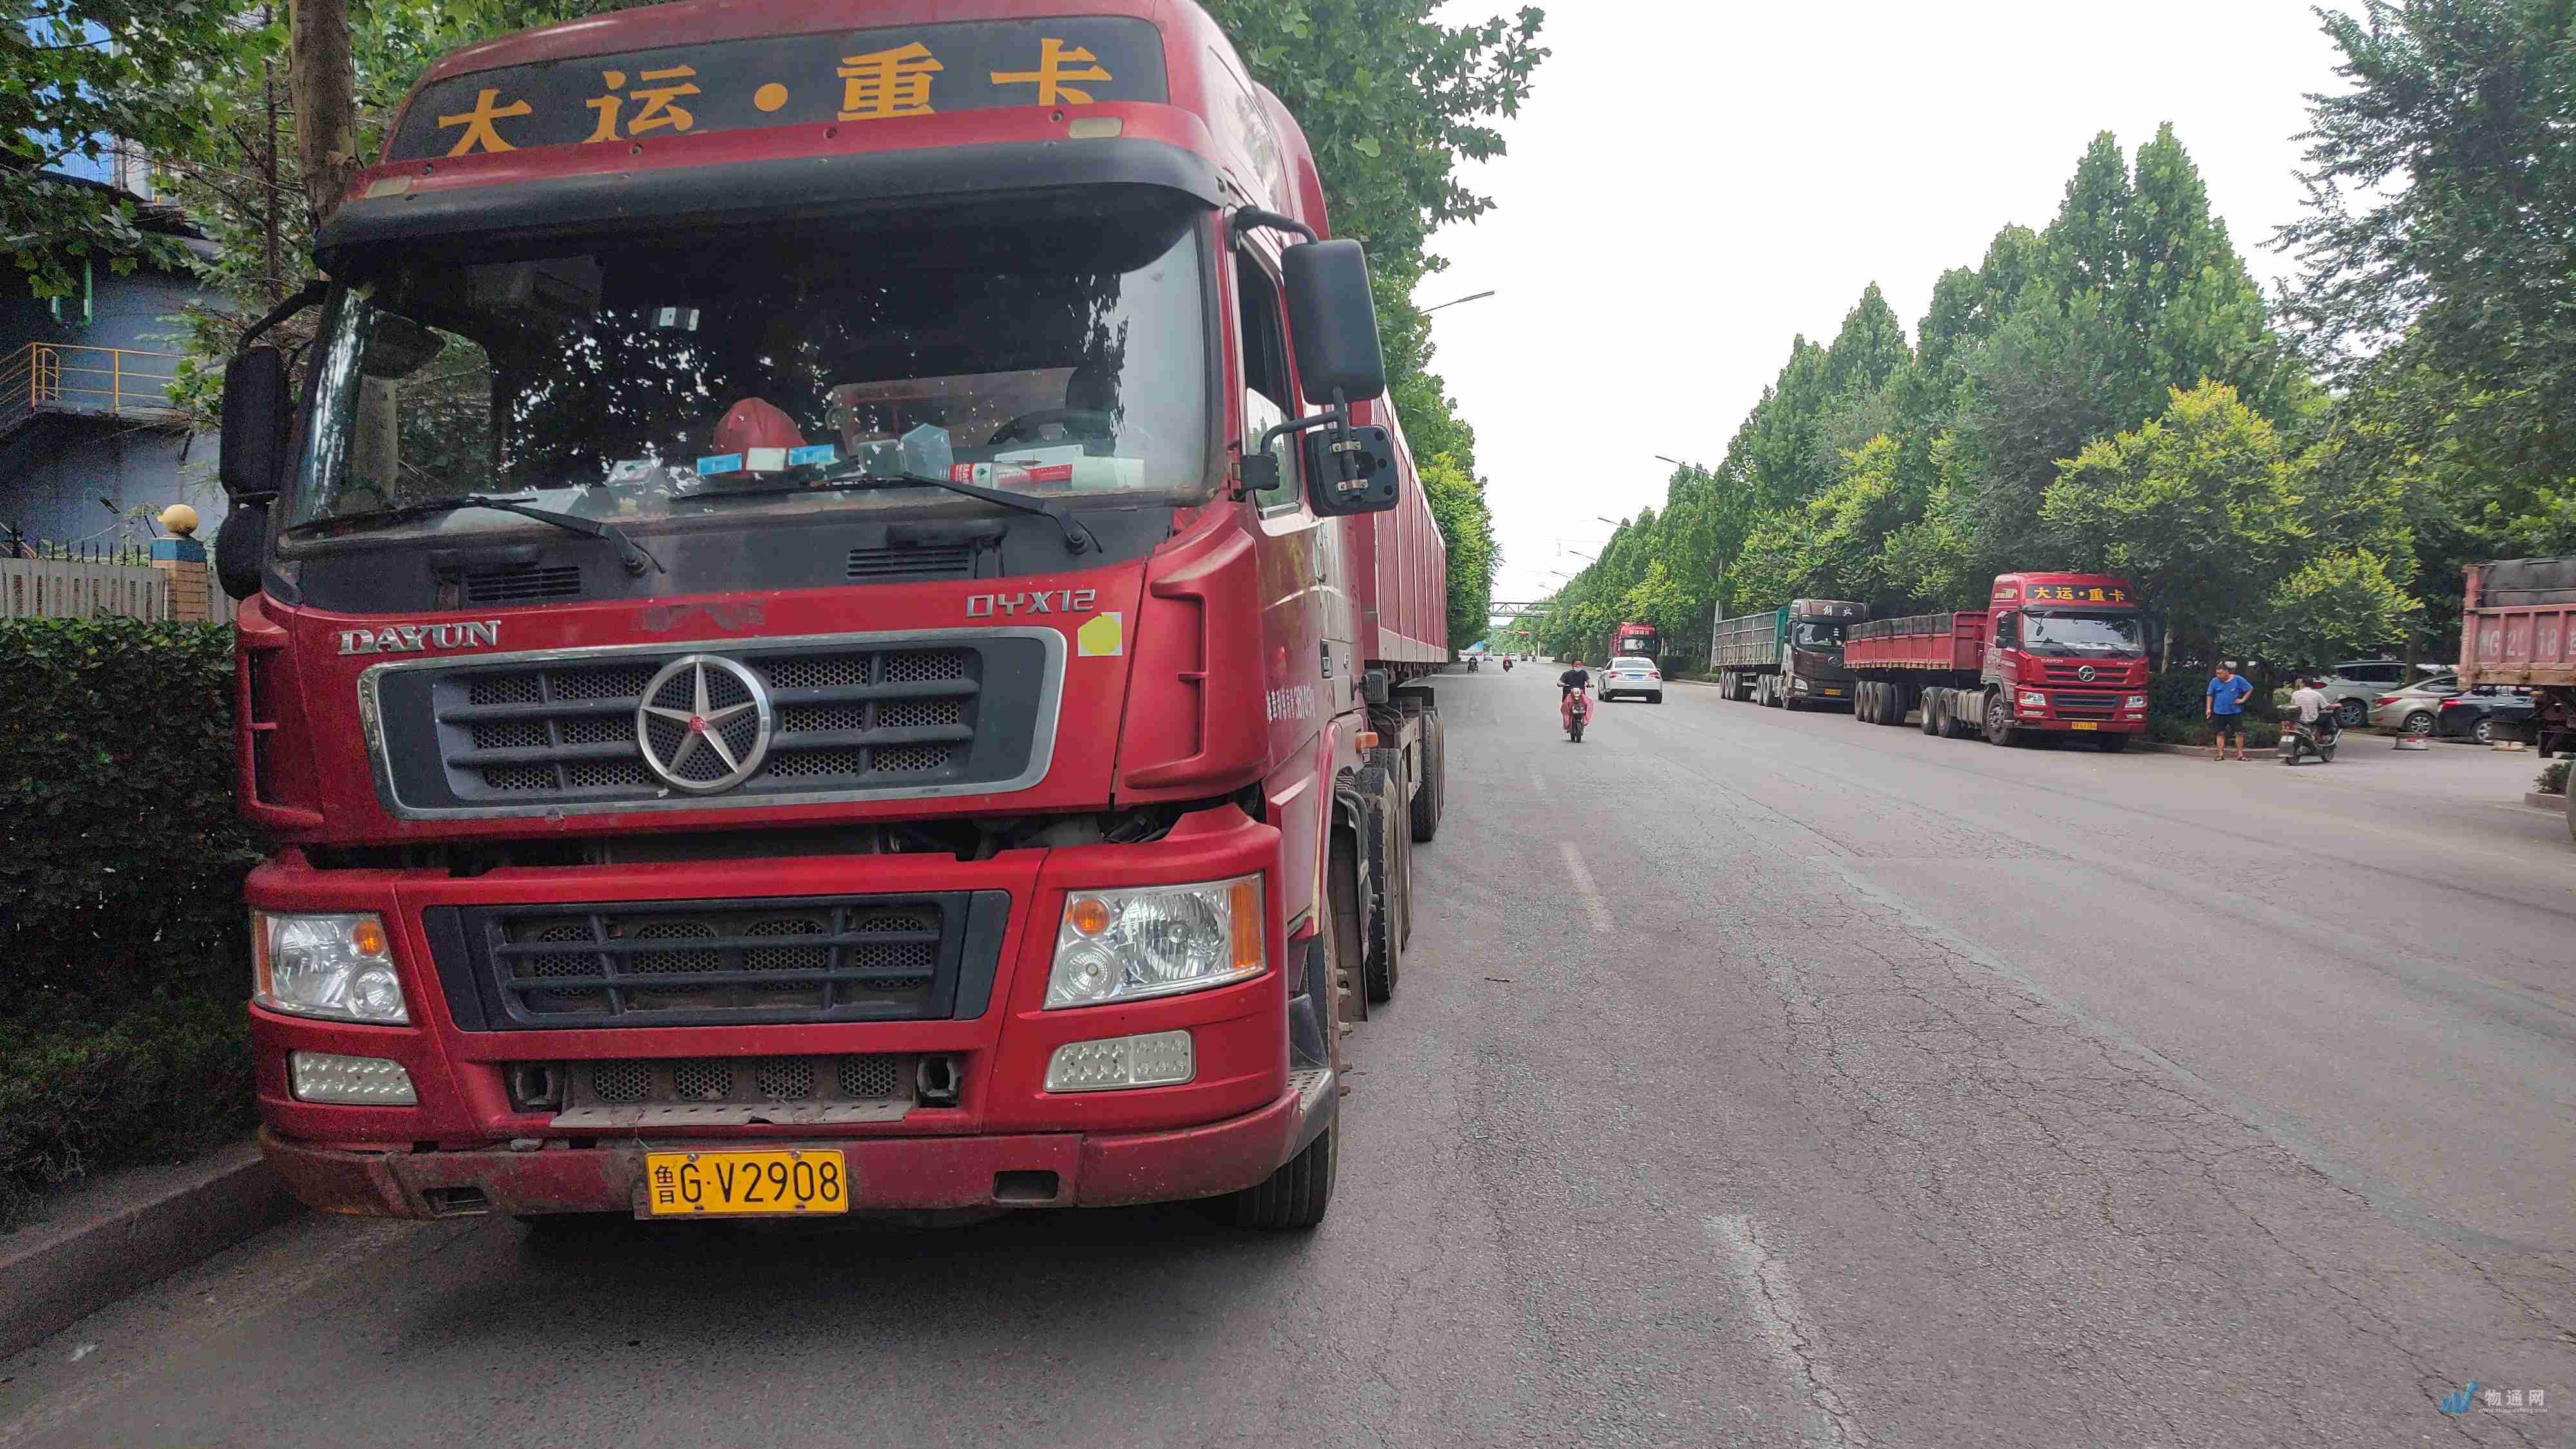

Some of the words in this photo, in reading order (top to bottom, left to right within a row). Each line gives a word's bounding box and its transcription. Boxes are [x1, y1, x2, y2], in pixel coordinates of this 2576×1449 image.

[438, 38, 1113, 157] 大运·重卡
[2034, 587, 2125, 602] 大运·重卡
[337, 620, 502, 655] DAYUN
